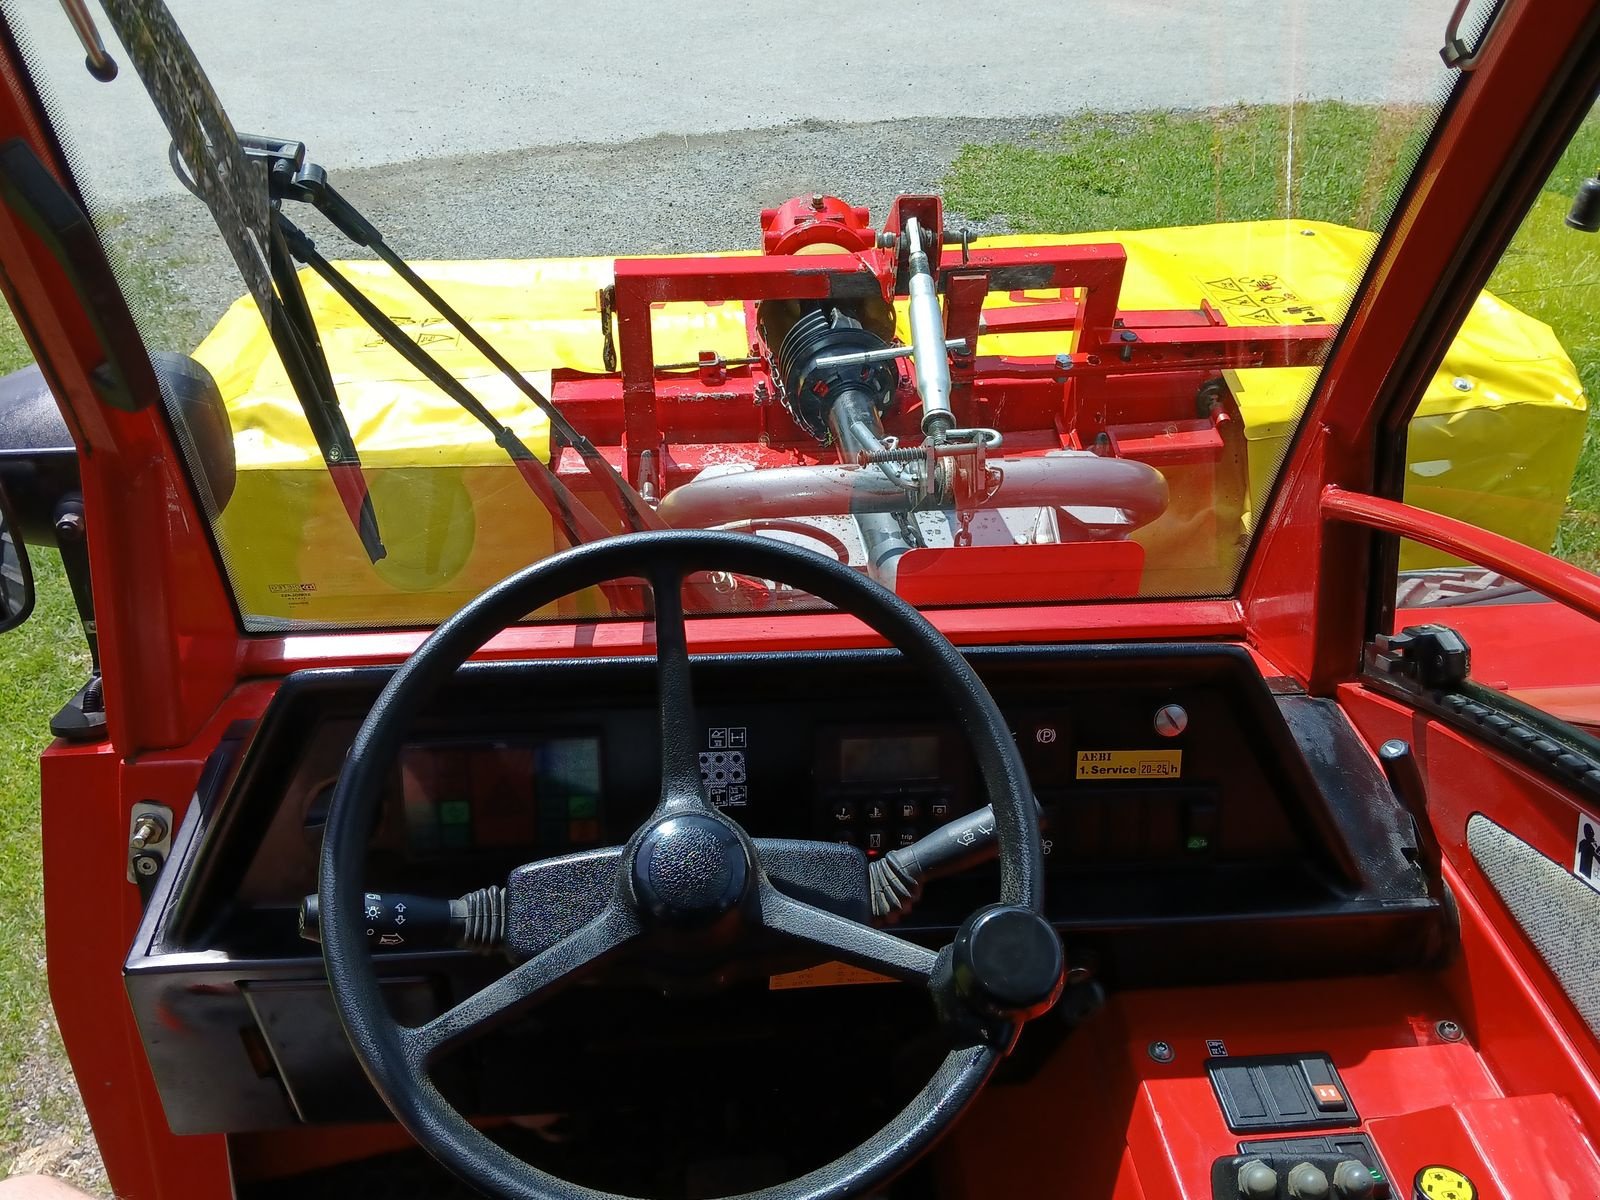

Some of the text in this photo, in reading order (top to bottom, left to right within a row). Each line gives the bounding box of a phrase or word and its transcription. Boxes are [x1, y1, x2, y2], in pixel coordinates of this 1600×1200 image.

[1081, 752, 1112, 761] AEBI
[1079, 765, 1089, 775] 1.
[1091, 765, 1137, 775] Service
[1170, 764, 1178, 773] h
[901, 833, 913, 841] trip
